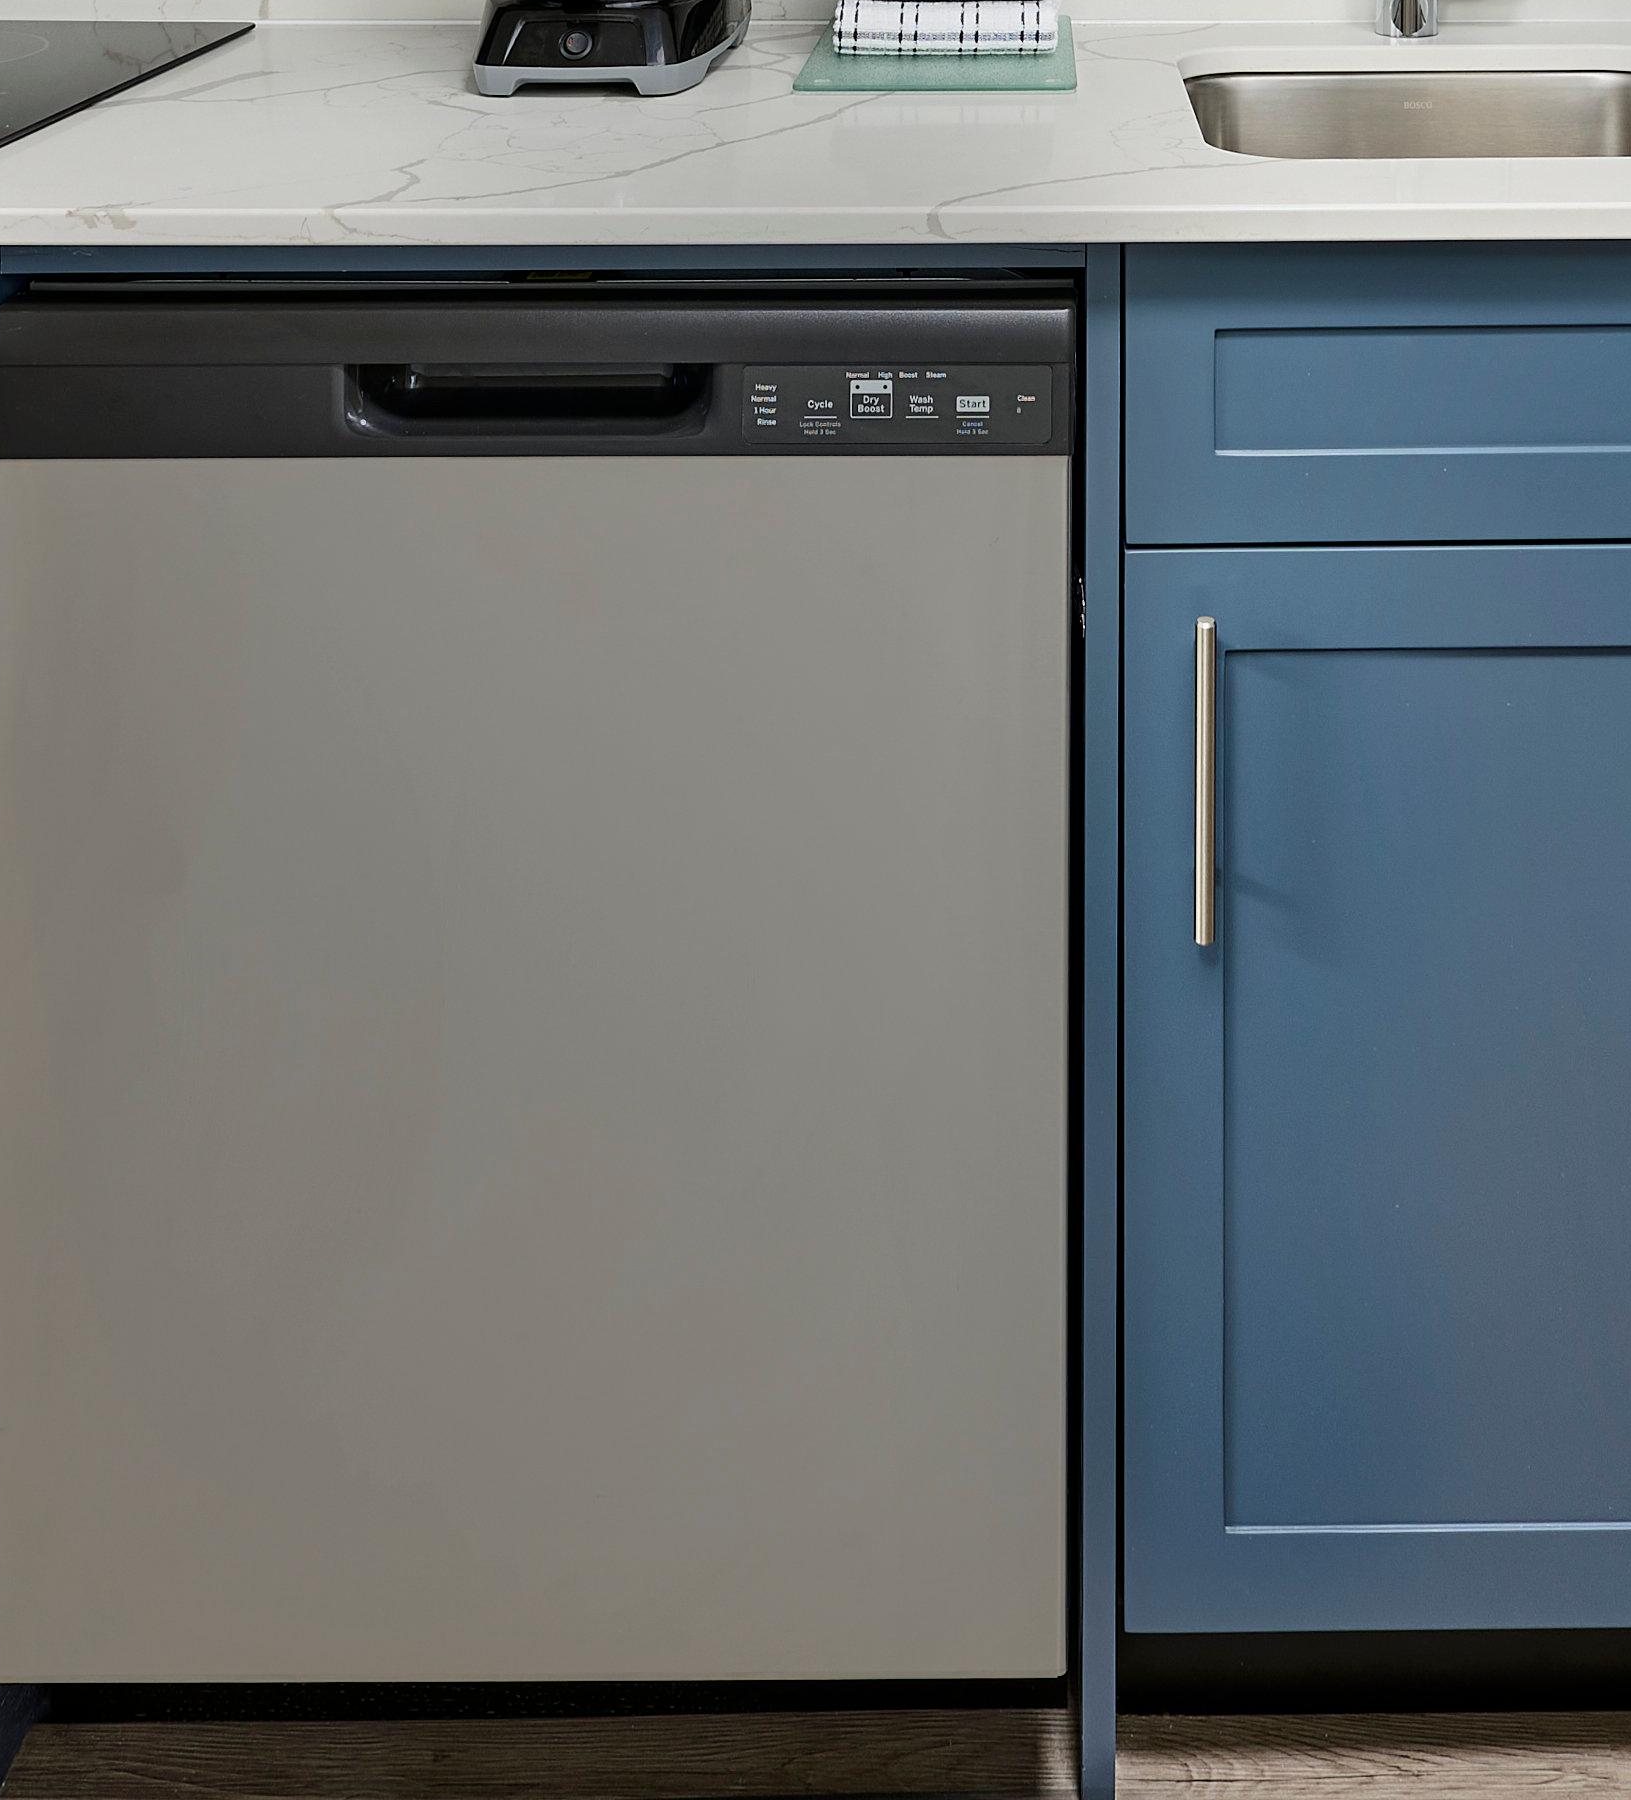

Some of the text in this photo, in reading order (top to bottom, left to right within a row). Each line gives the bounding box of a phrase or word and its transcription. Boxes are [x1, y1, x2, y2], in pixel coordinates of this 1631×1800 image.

[755, 384, 777, 392] Heavy
[863, 395, 880, 406] Dry
[909, 395, 934, 404] Wash
[959, 399, 987, 408] Start
[807, 400, 834, 410] Cycle
[857, 405, 885, 413] Boost
[909, 404, 934, 414] Temp
[757, 418, 777, 426] Rinse
